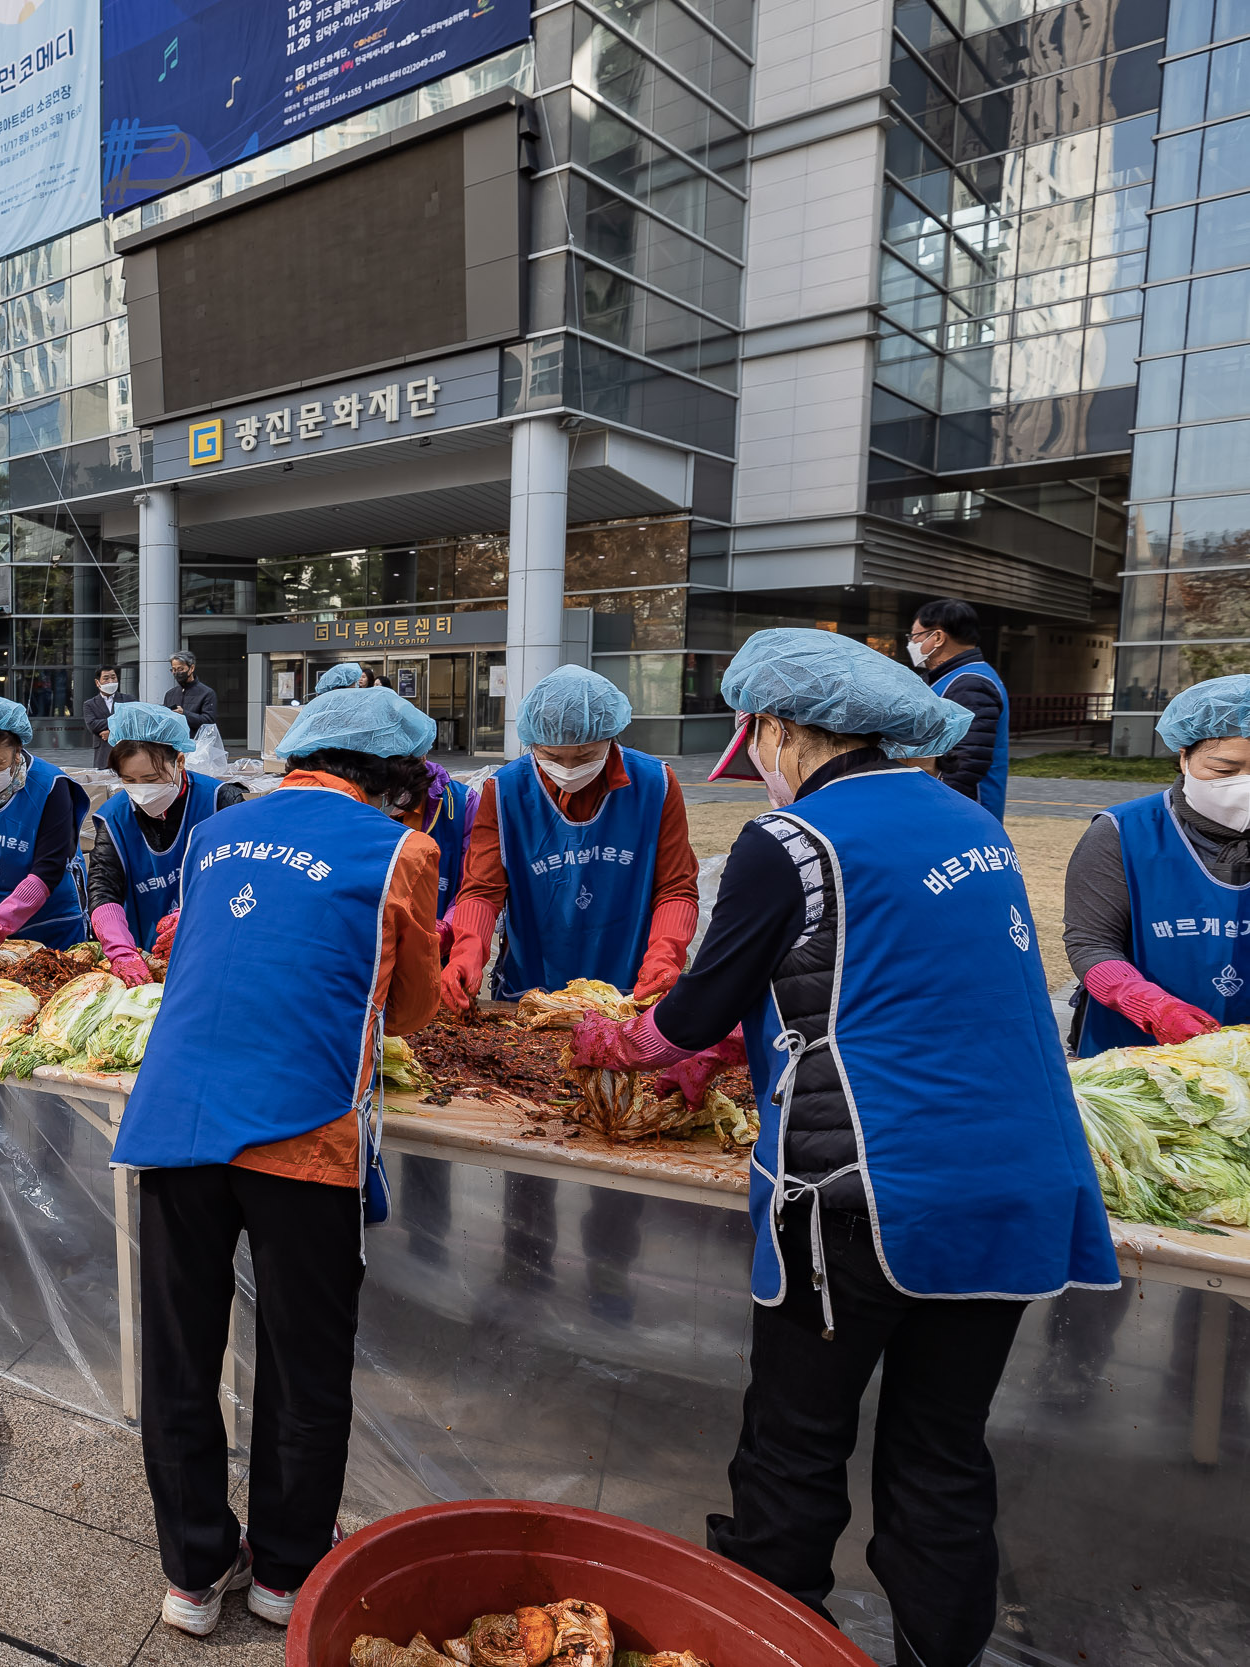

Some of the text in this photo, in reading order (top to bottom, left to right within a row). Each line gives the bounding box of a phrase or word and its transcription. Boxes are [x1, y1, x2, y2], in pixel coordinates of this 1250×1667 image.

[37, 84, 72, 114] 소공연장
[235, 376, 441, 451] 광진문화재단
[335, 616, 452, 640] 나루아트센터
[399, 637, 430, 645] Center
[200, 841, 333, 882] 바르게살기운동
[530, 845, 635, 876] 바르게살기운동
